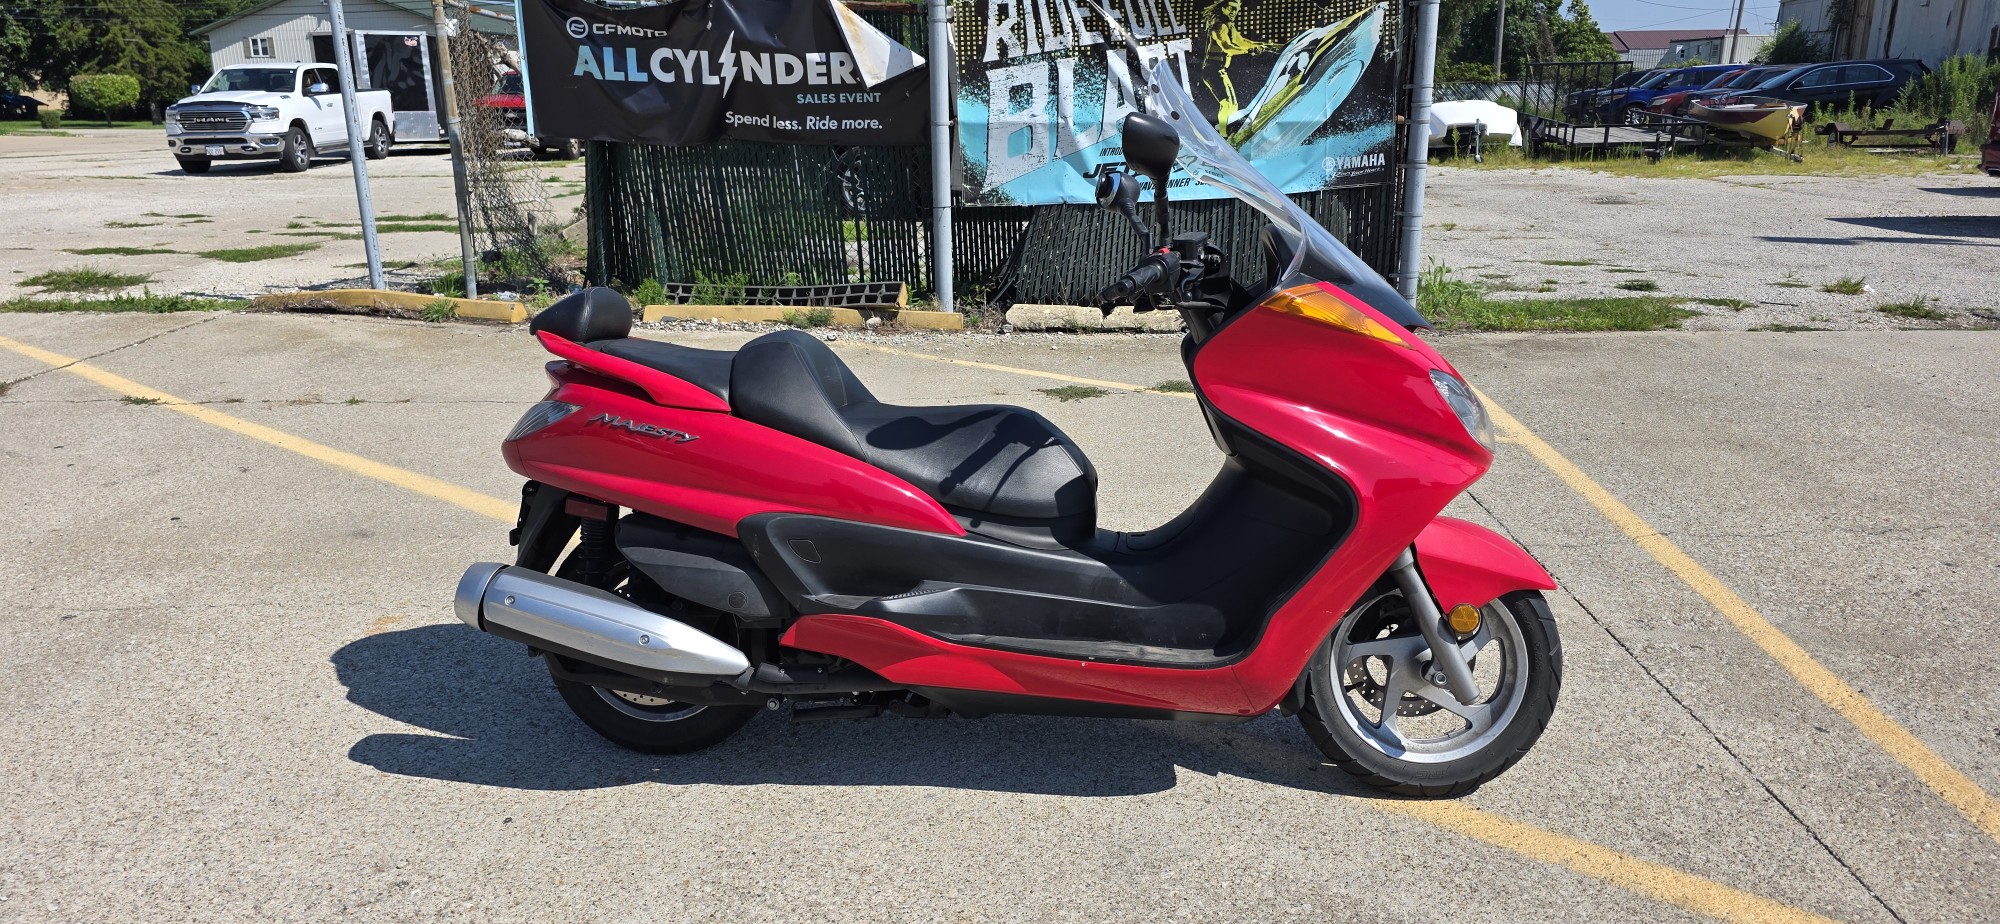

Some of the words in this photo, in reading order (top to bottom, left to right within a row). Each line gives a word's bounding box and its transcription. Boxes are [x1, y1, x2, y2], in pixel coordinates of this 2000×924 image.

[592, 23, 667, 38] CFMOTO
[796, 93, 836, 104] SALES
[839, 92, 881, 103] EVENT
[725, 111, 769, 127] Spend
[773, 116, 802, 130] less.
[806, 116, 838, 130] Ride
[842, 119, 883, 130] more.
[1336, 153, 1386, 169] YAMAHA
[588, 413, 700, 444] MAJESTY
